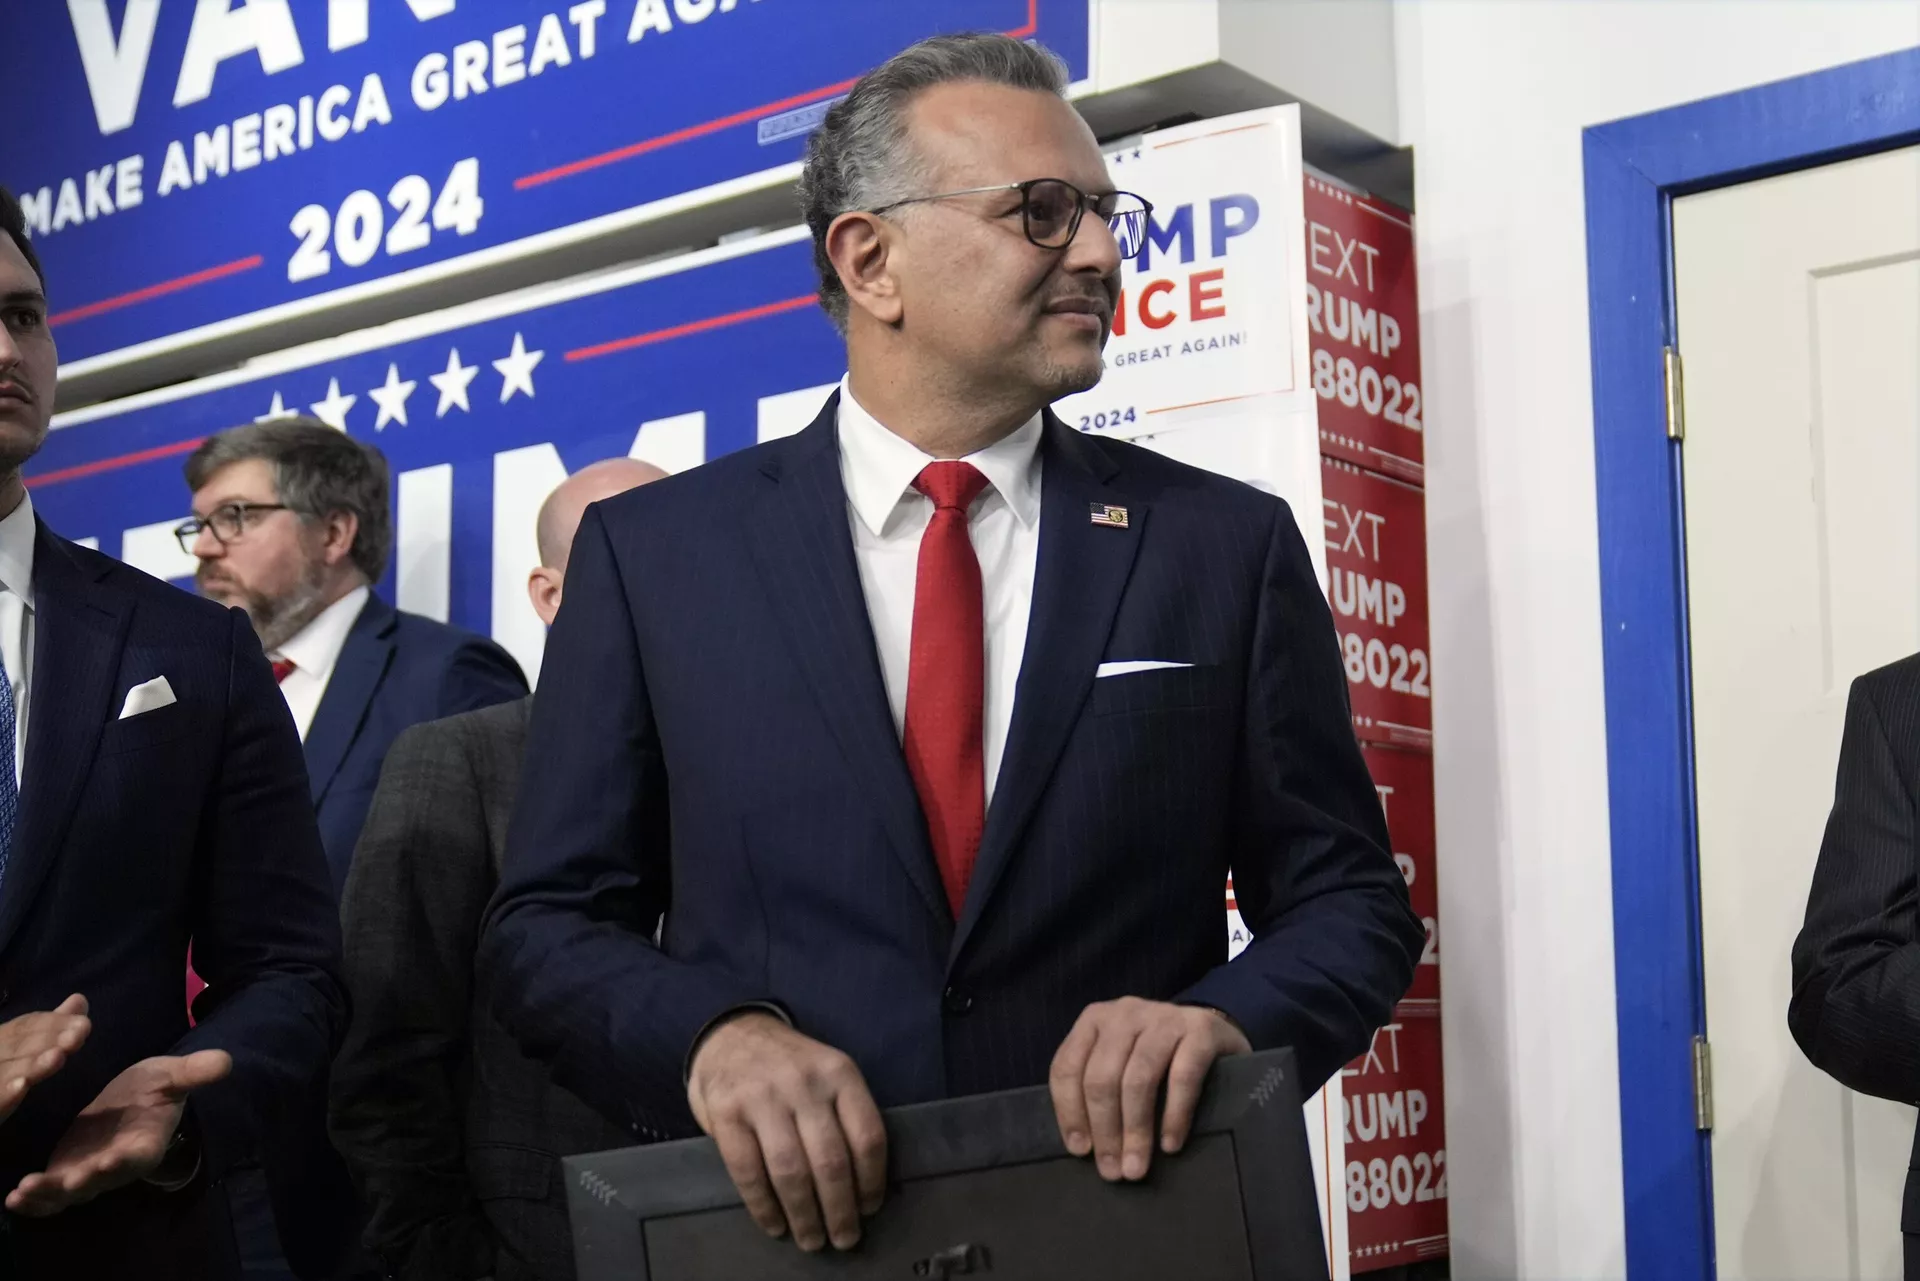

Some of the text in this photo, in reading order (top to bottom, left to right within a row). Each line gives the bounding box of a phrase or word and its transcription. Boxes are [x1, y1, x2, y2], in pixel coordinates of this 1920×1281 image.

[20, 153, 144, 240] MAKE
[157, 72, 392, 197] AMERICA
[410, 0, 606, 111] GREAT
[287, 157, 484, 283] 2024
[1304, 220, 1380, 293] EXT
[1115, 345, 1172, 367] GREAT
[1313, 348, 1423, 431] 88022
[1080, 406, 1137, 431] 2024
[1329, 566, 1406, 627] UMP
[1335, 630, 1429, 697] 8022
